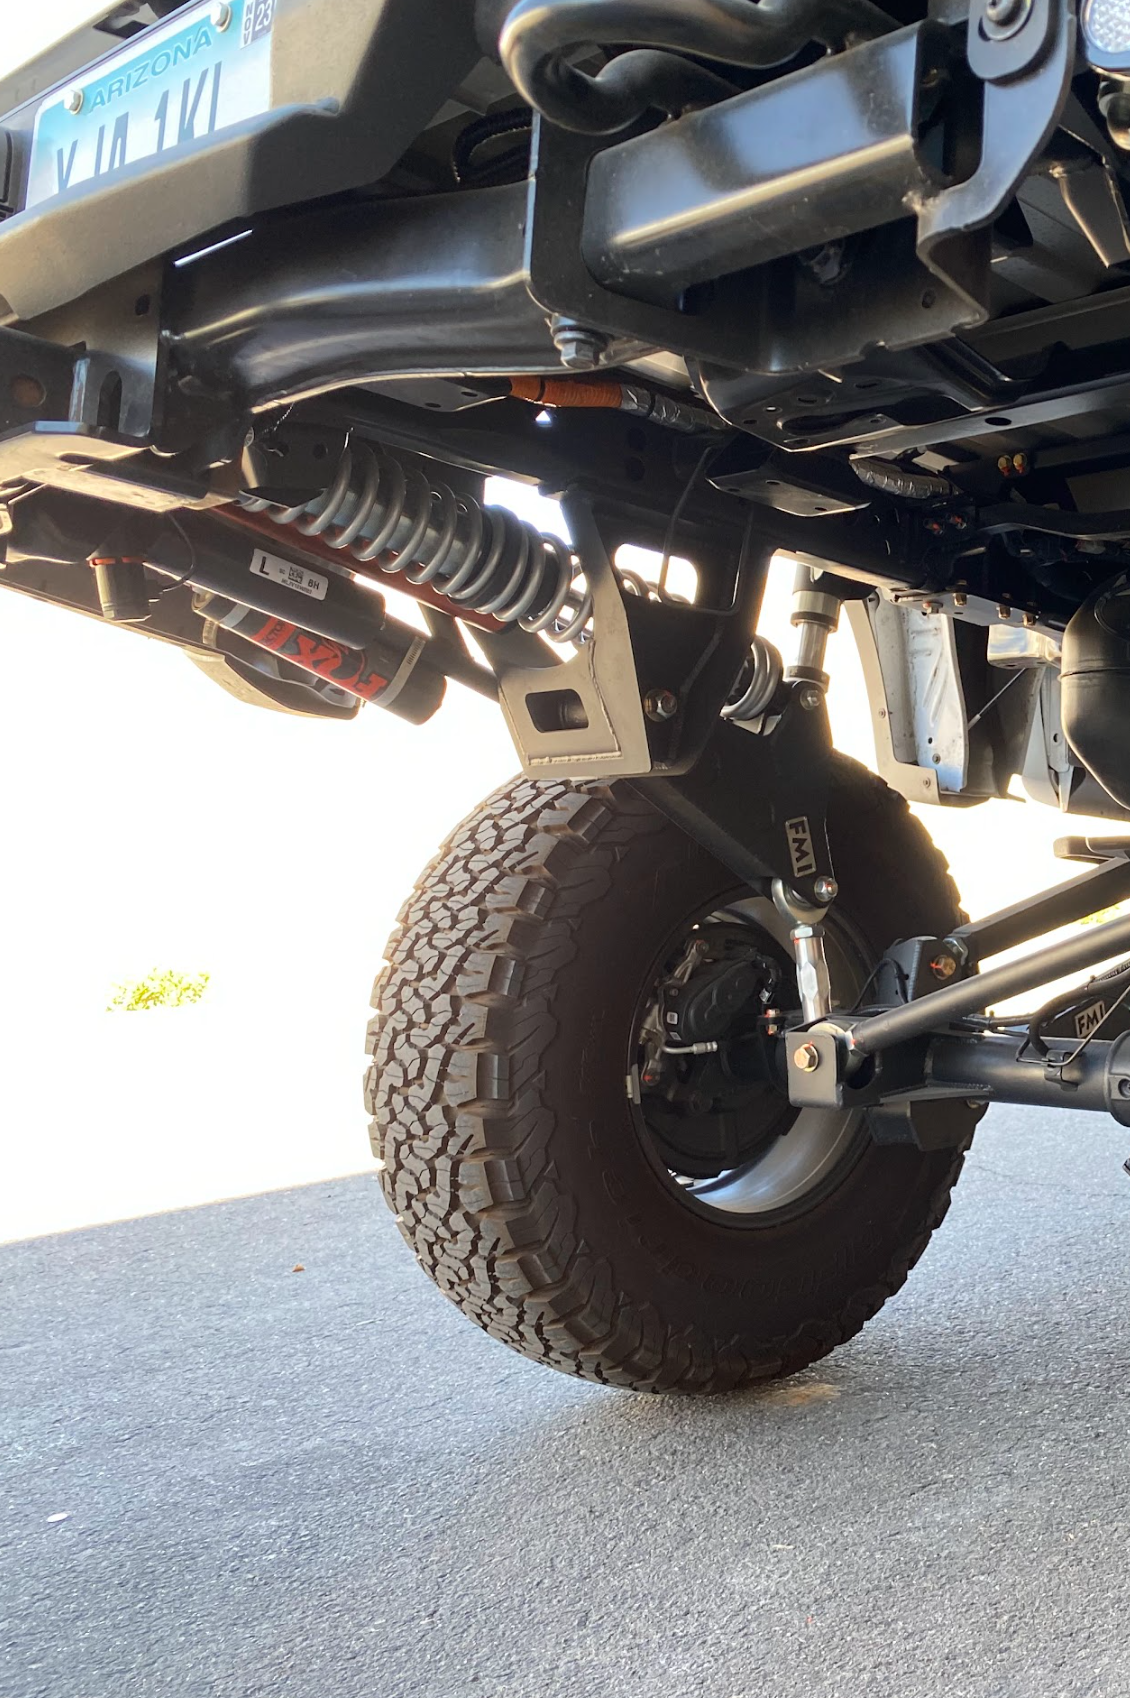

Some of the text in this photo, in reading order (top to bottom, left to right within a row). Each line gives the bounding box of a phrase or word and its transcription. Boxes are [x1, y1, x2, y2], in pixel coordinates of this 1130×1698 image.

[255, 0, 272, 31] 23
[89, 27, 213, 112] ARIZONA
[259, 556, 270, 576] L
[282, 634, 388, 701] FOX
[789, 820, 811, 873] FMI
[1077, 1003, 1105, 1035] FMI
